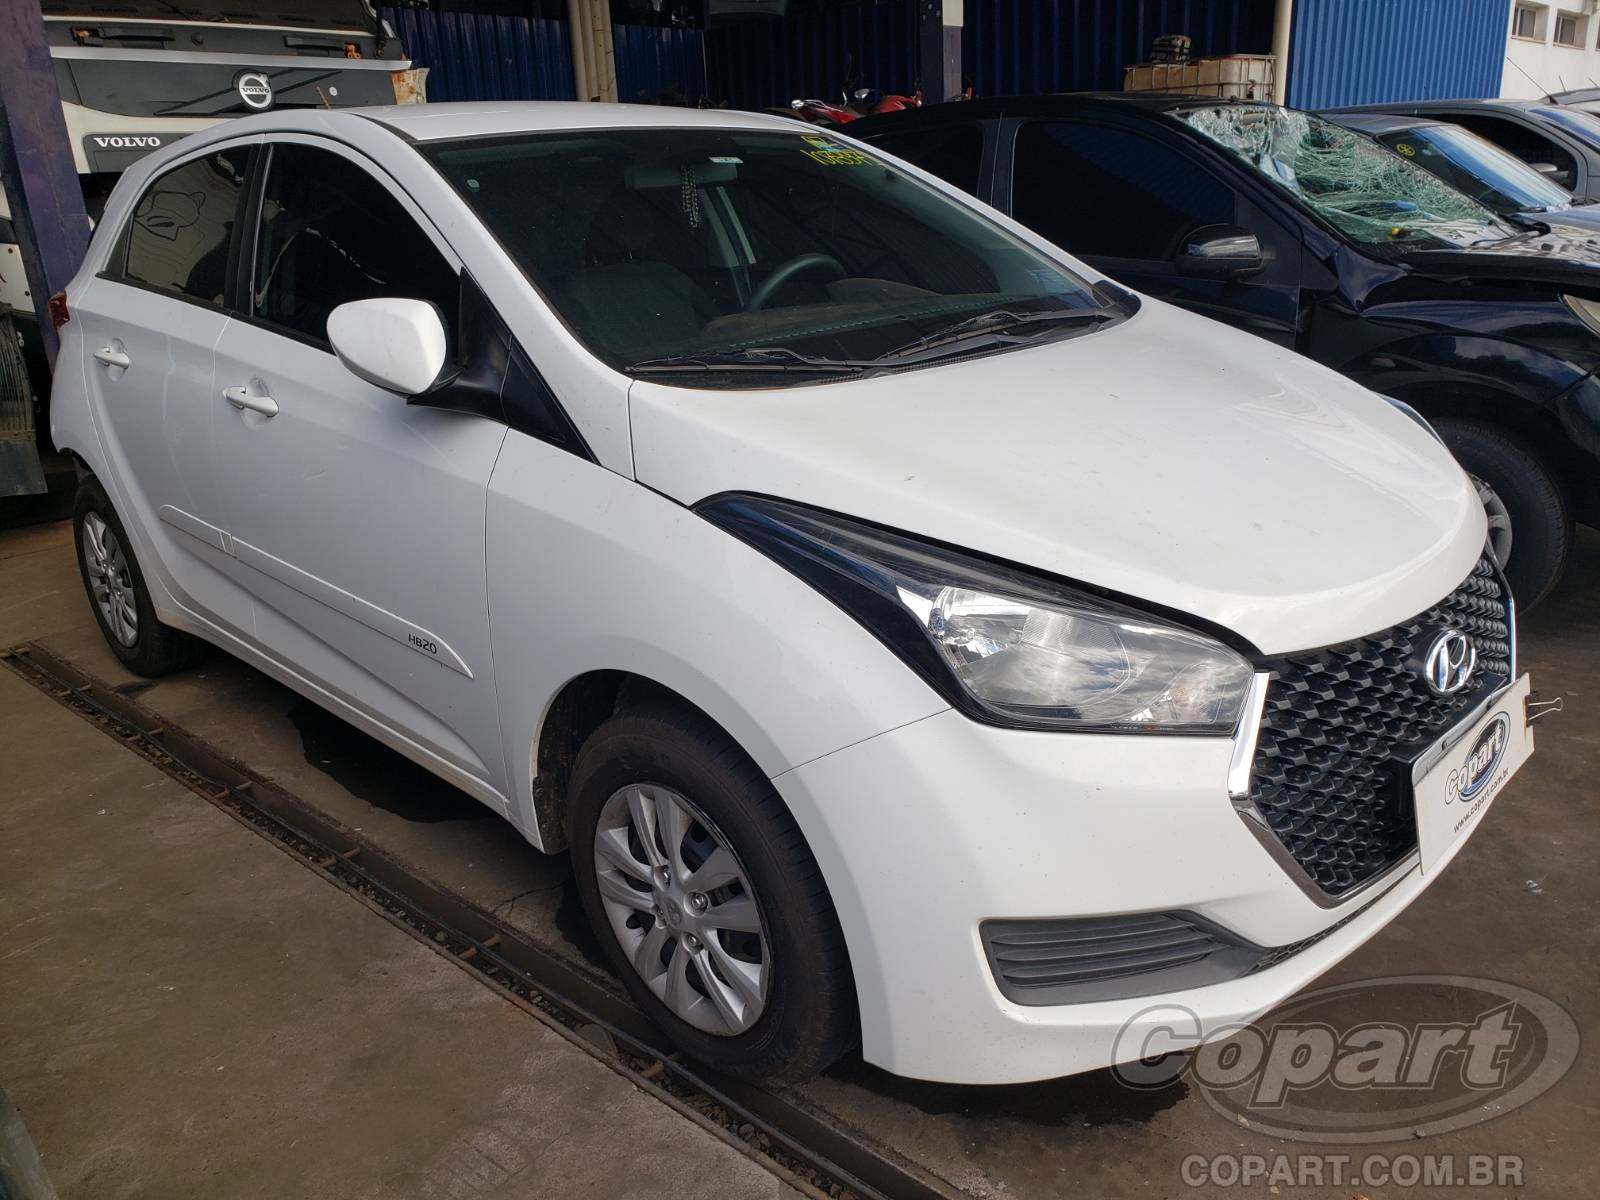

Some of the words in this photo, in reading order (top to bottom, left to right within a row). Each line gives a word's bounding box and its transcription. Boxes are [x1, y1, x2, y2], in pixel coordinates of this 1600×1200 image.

[94, 136, 161, 148] VOLVO
[408, 633, 437, 655] HB20
[1444, 718, 1505, 806] Copart
[1453, 767, 1510, 833] www.copart.com.br
